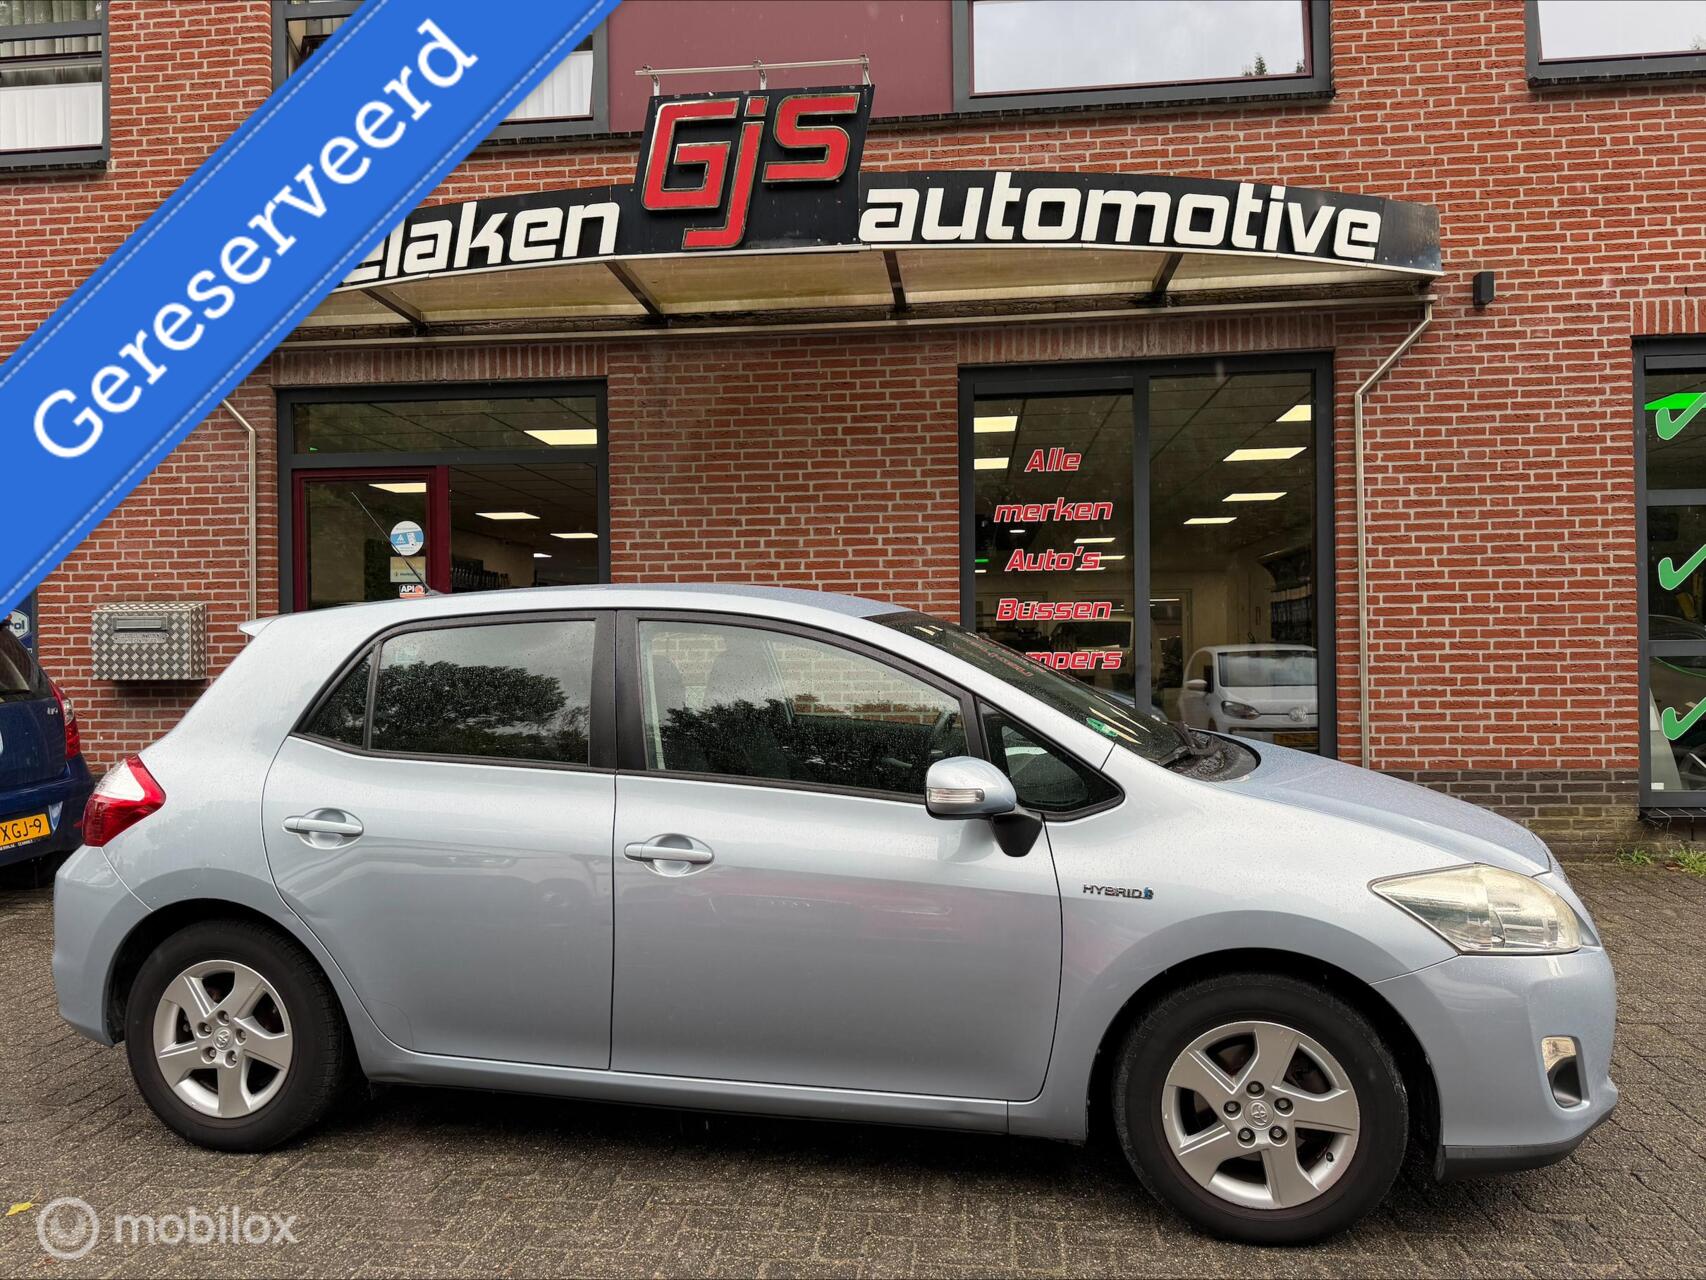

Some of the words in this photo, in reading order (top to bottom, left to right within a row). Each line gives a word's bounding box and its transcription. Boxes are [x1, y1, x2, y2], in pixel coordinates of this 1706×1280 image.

[858, 171, 1382, 260] automotive
[1024, 447, 1082, 473] Alle
[993, 497, 1113, 523] merken
[1004, 546, 1102, 572] Auto's
[1082, 884, 1142, 899] HYBRID
